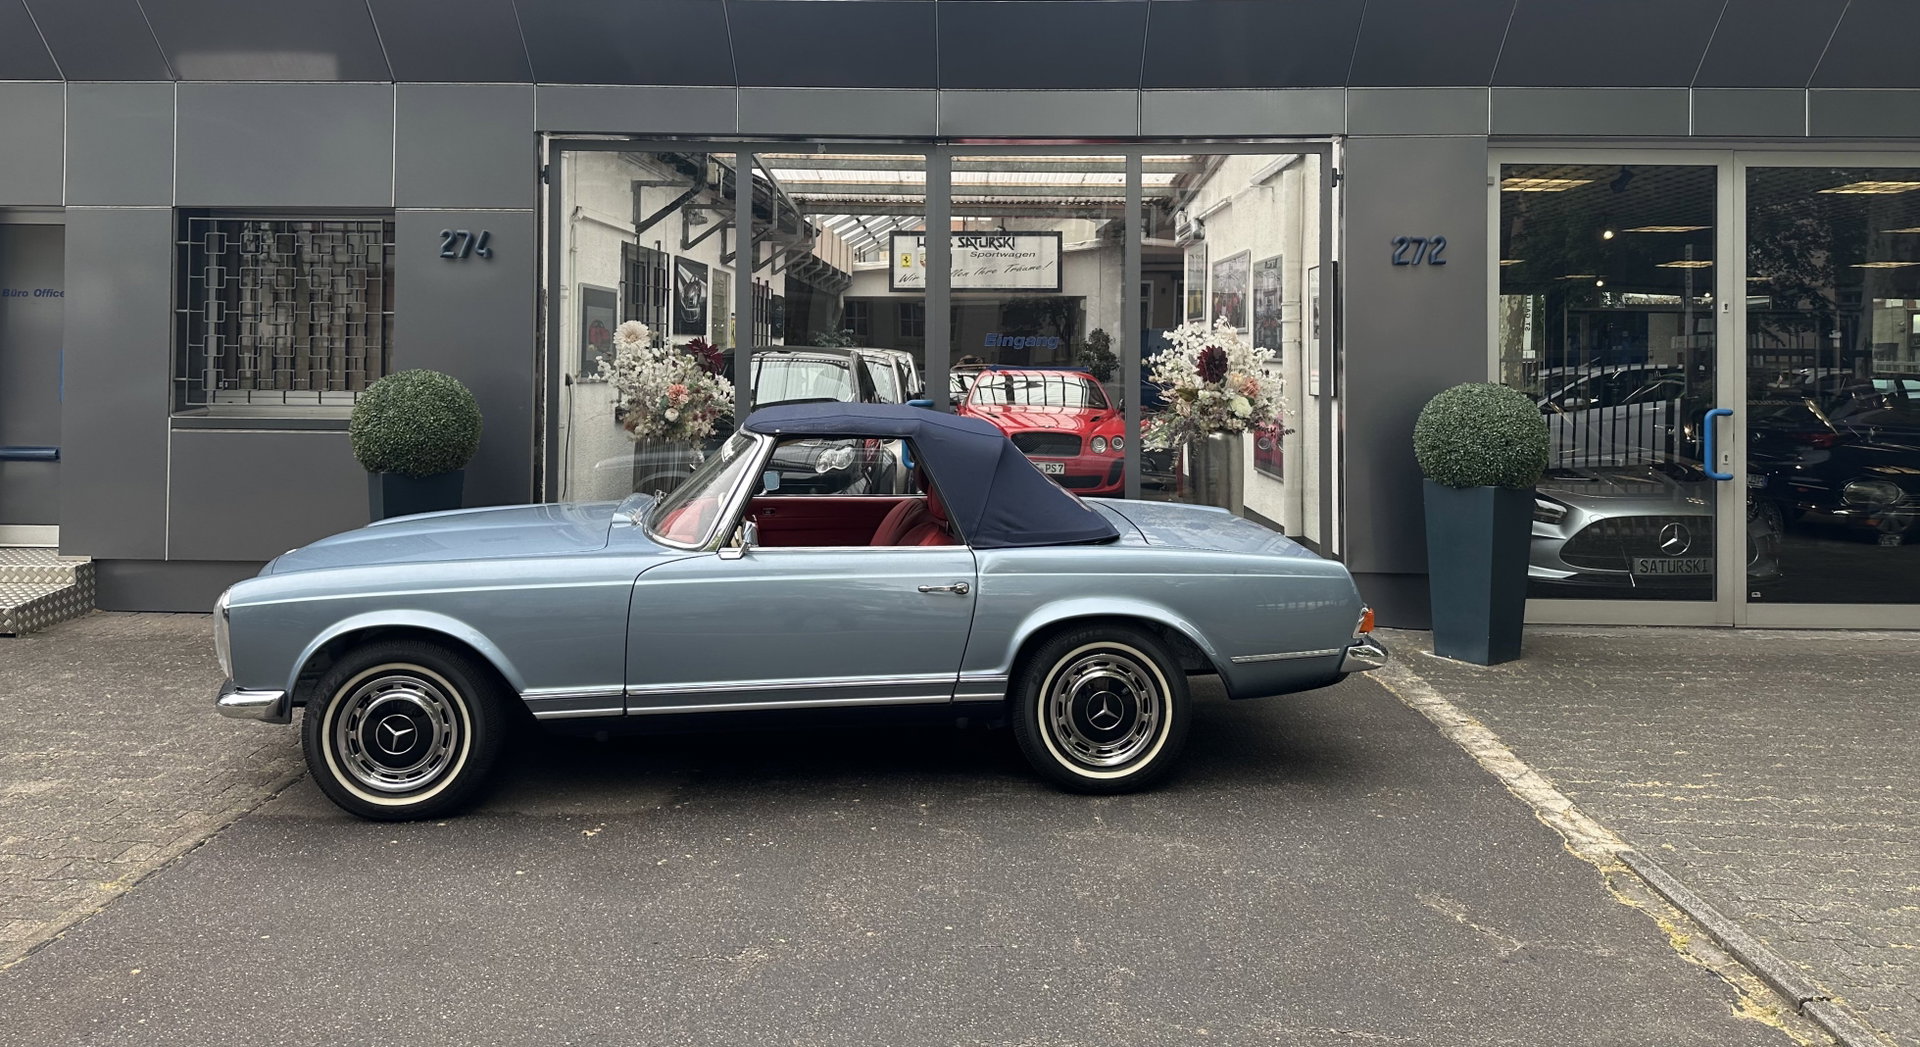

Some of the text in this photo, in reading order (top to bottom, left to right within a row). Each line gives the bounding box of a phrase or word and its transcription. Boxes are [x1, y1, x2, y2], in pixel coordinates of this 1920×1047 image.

[440, 228, 493, 259] 274
[958, 237, 1015, 250] SATURSKI
[1392, 235, 1447, 265] 272
[970, 251, 1036, 259] Sportwagen
[899, 272, 920, 283] Wir
[974, 266, 998, 276] Ihre
[2, 288, 64, 297] Büro Office
[984, 332, 1060, 350] Eingang
[1639, 559, 1708, 573] SATURSKI
